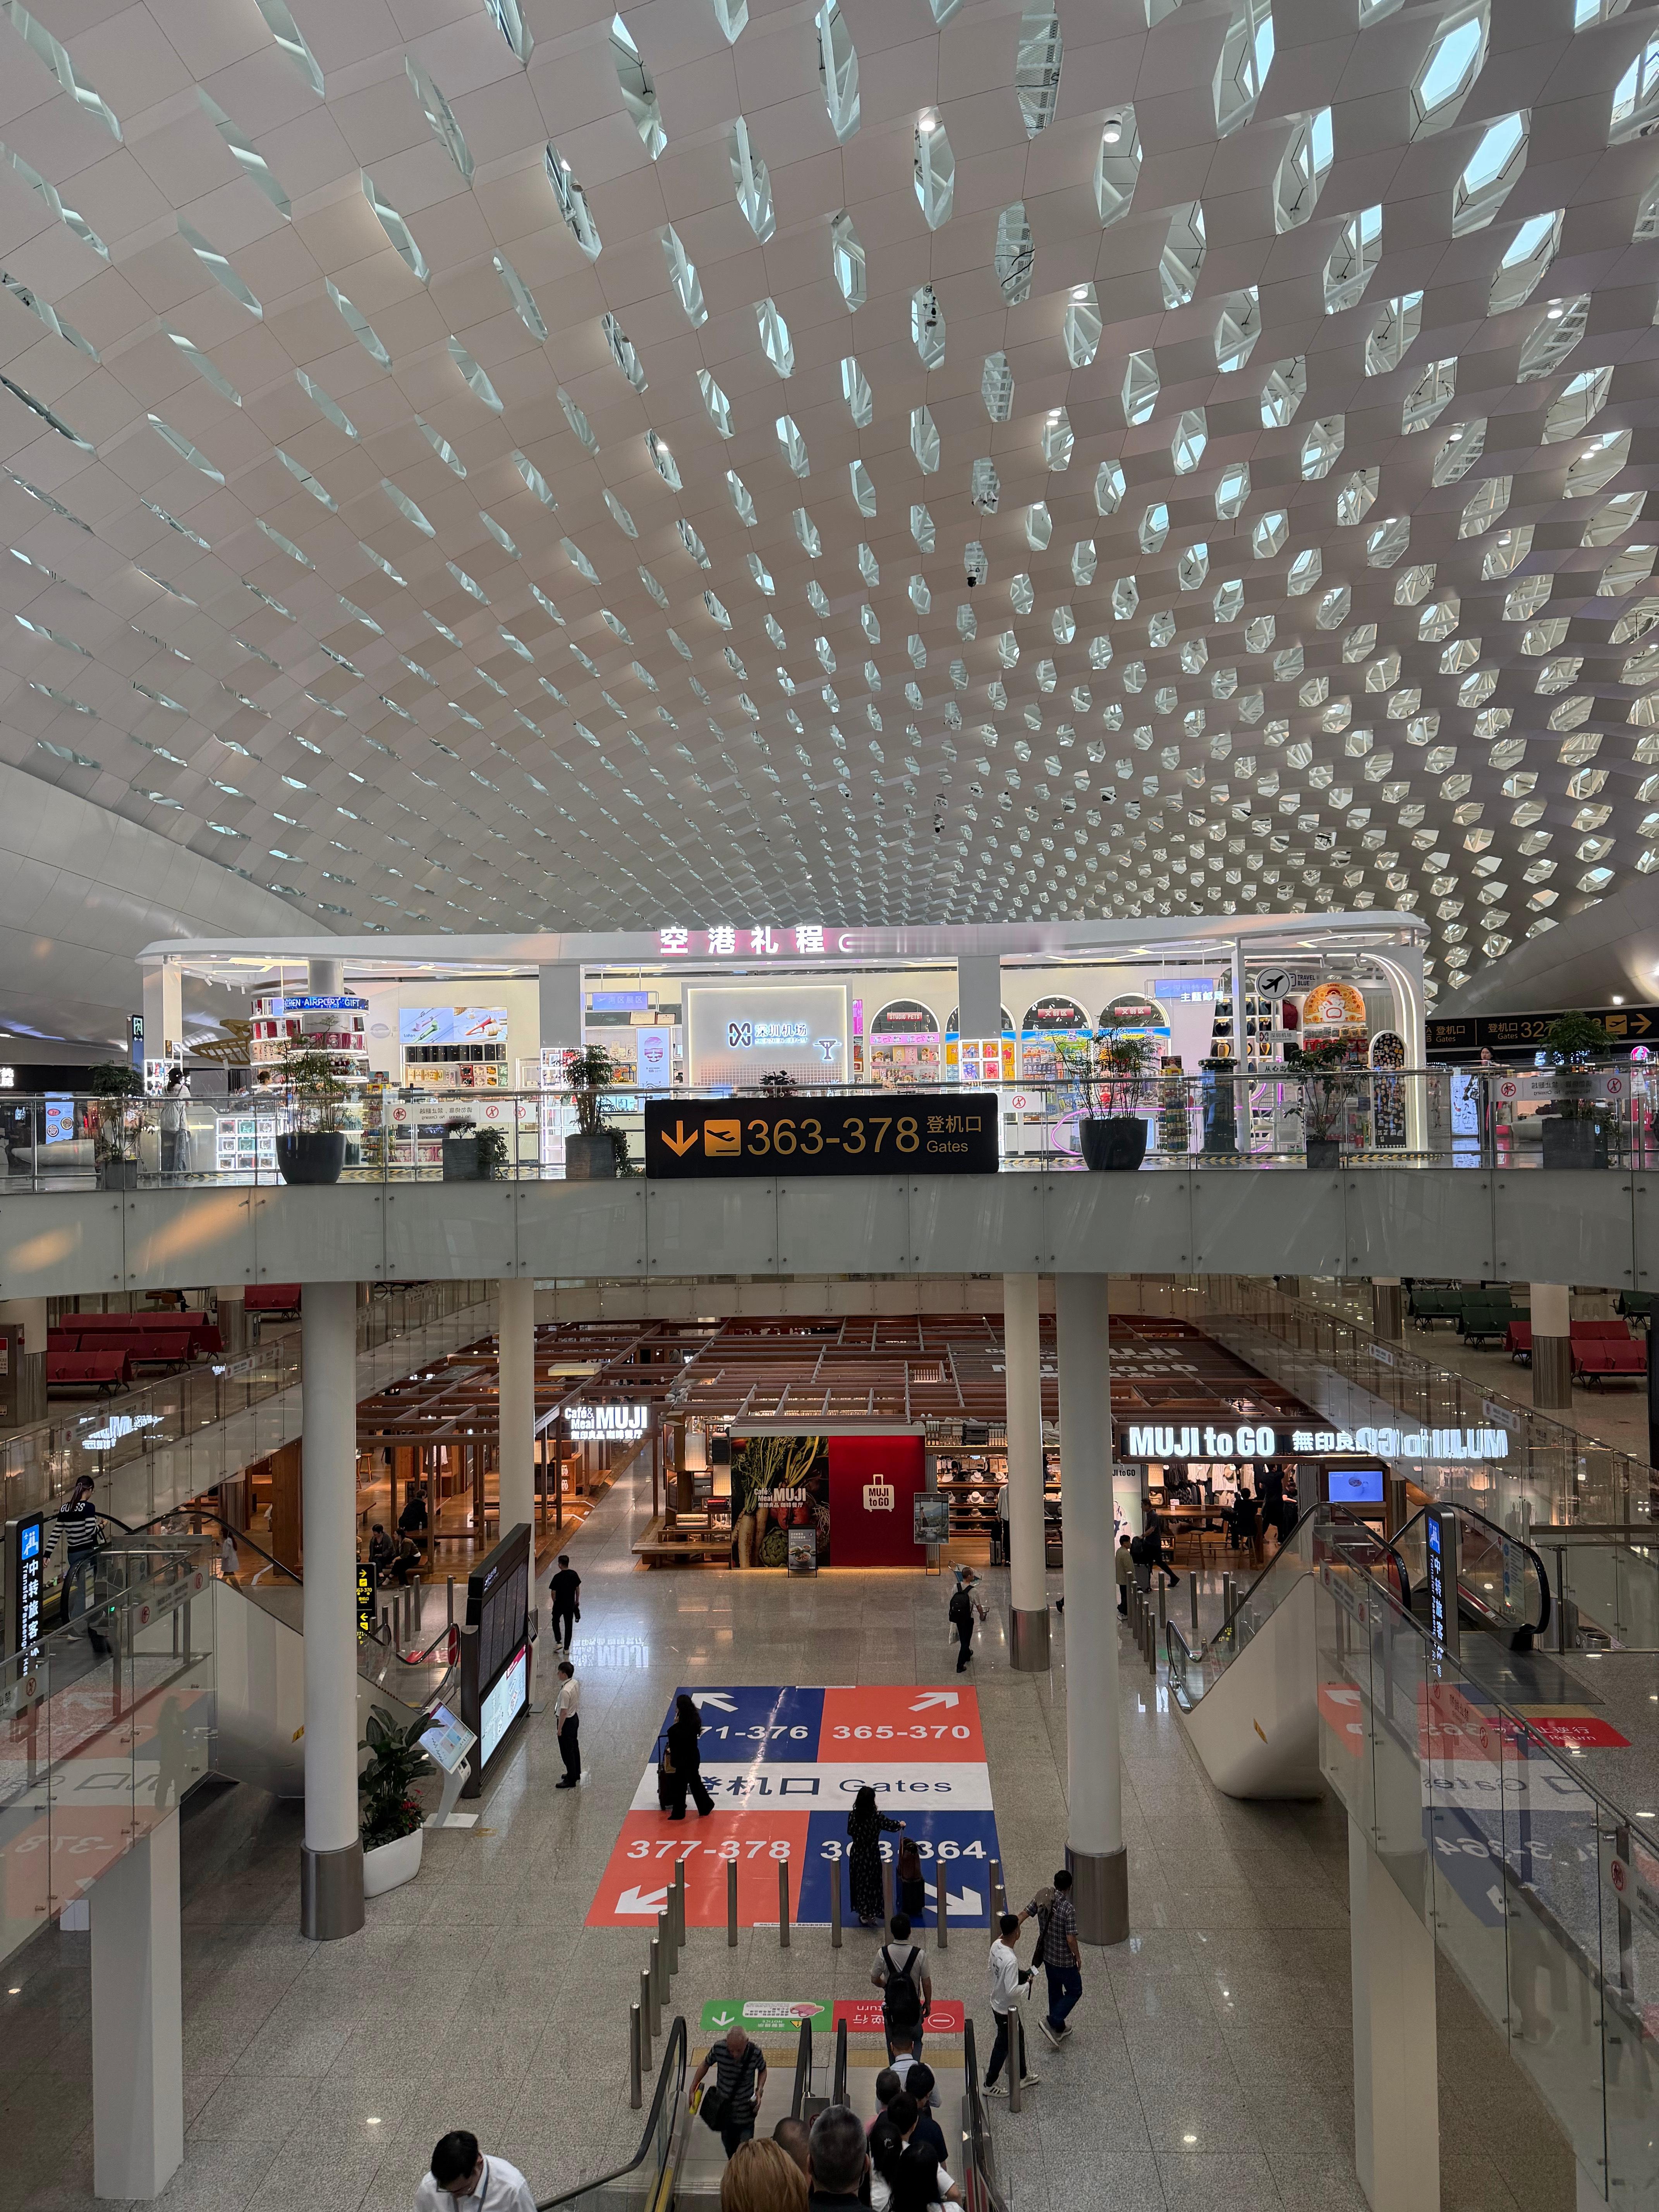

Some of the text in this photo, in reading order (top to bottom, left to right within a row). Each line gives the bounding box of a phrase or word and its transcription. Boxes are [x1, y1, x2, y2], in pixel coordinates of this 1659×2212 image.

[660, 925, 825, 954] 空港礼程
[304, 998, 340, 1006] AIRPORT
[1180, 991, 1224, 1002] 主题邮局
[755, 1024, 807, 1036] 深圳机场
[1436, 1025, 1465, 1035] 登机口
[1488, 1022, 1518, 1033] 登机口
[927, 1115, 982, 1133] 登机口
[747, 1118, 919, 1156] 363-378
[927, 1140, 968, 1152] Gates
[1109, 1348, 1183, 1357] UJI
[596, 1406, 647, 1429] MUJI
[571, 1419, 595, 1429] Meal
[1129, 1426, 1275, 1457] MUJI to GO
[1292, 1431, 1367, 1452] 無印良
[774, 1488, 806, 1501] MUJI
[869, 1488, 889, 1497] MUJI
[60, 1502, 86, 1513] GUSS
[869, 1498, 889, 1506] to GO
[697, 1726, 809, 1739] 71-376
[832, 1726, 970, 1739] 365-370
[839, 1779, 953, 1793] Gates
[626, 1840, 791, 1859] 377-378
[820, 1840, 987, 1859] 33-364
[852, 2014, 884, 2025] 逆行
